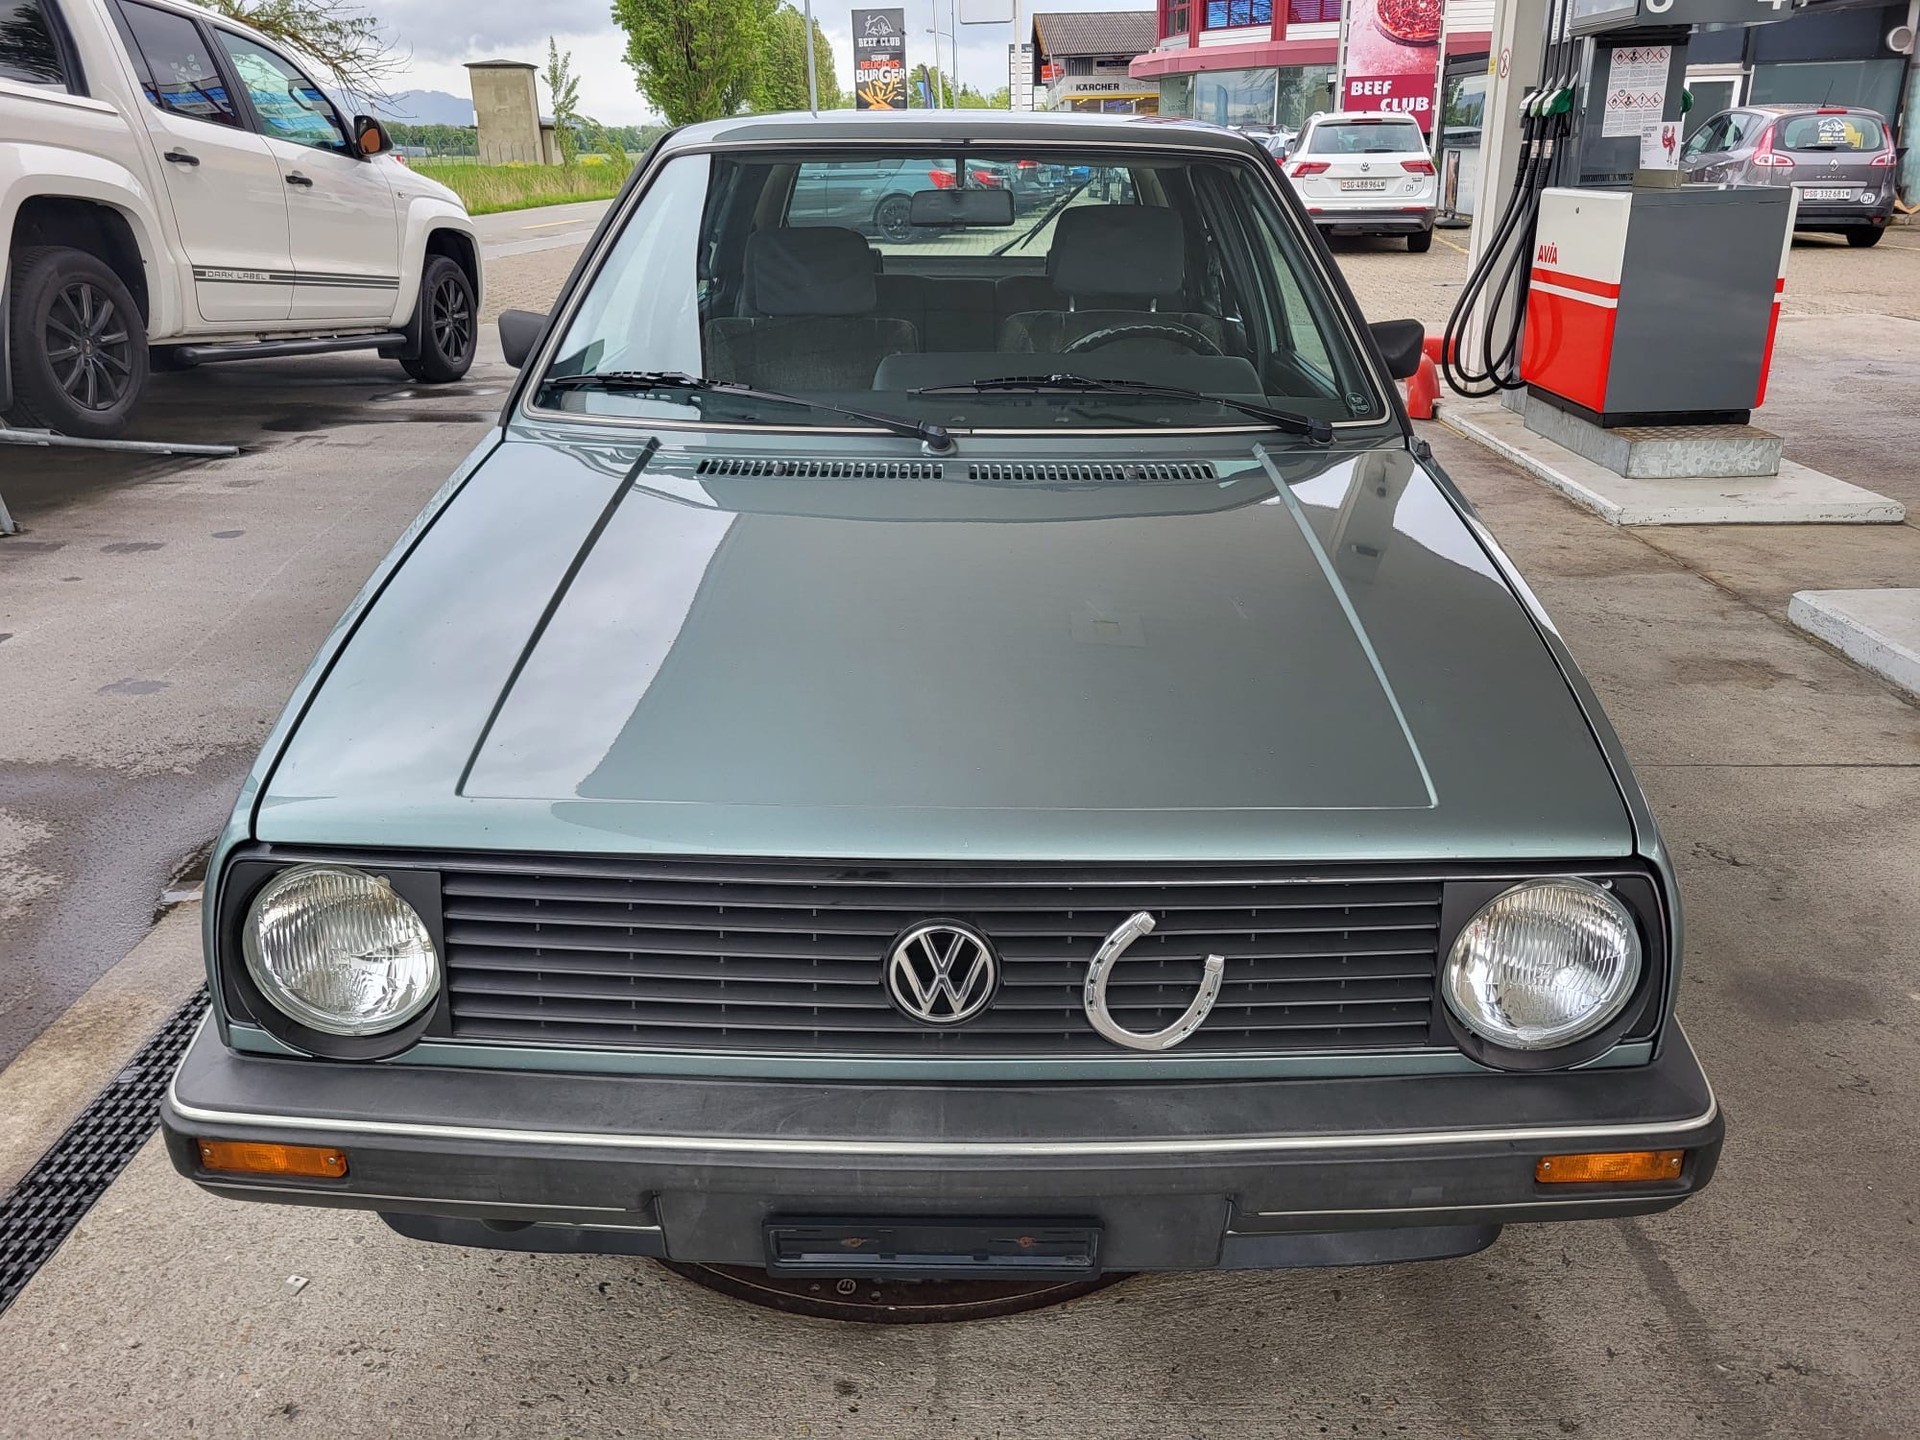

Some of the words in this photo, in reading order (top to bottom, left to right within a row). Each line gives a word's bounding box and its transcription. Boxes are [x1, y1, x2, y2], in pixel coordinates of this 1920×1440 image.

[858, 37, 878, 47] BEEF
[880, 36, 901, 46] CLUB
[860, 59, 901, 69] DELICIOUS
[856, 66, 906, 83] BURGER
[1075, 82, 1120, 92] KÄRCHER
[1351, 81, 1392, 96] BEEF
[1380, 96, 1430, 112] CLUB
[1405, 184, 1414, 192] CH
[1862, 194, 1874, 203] CH
[207, 270, 234, 279] DARK
[237, 272, 267, 280] LABEL
